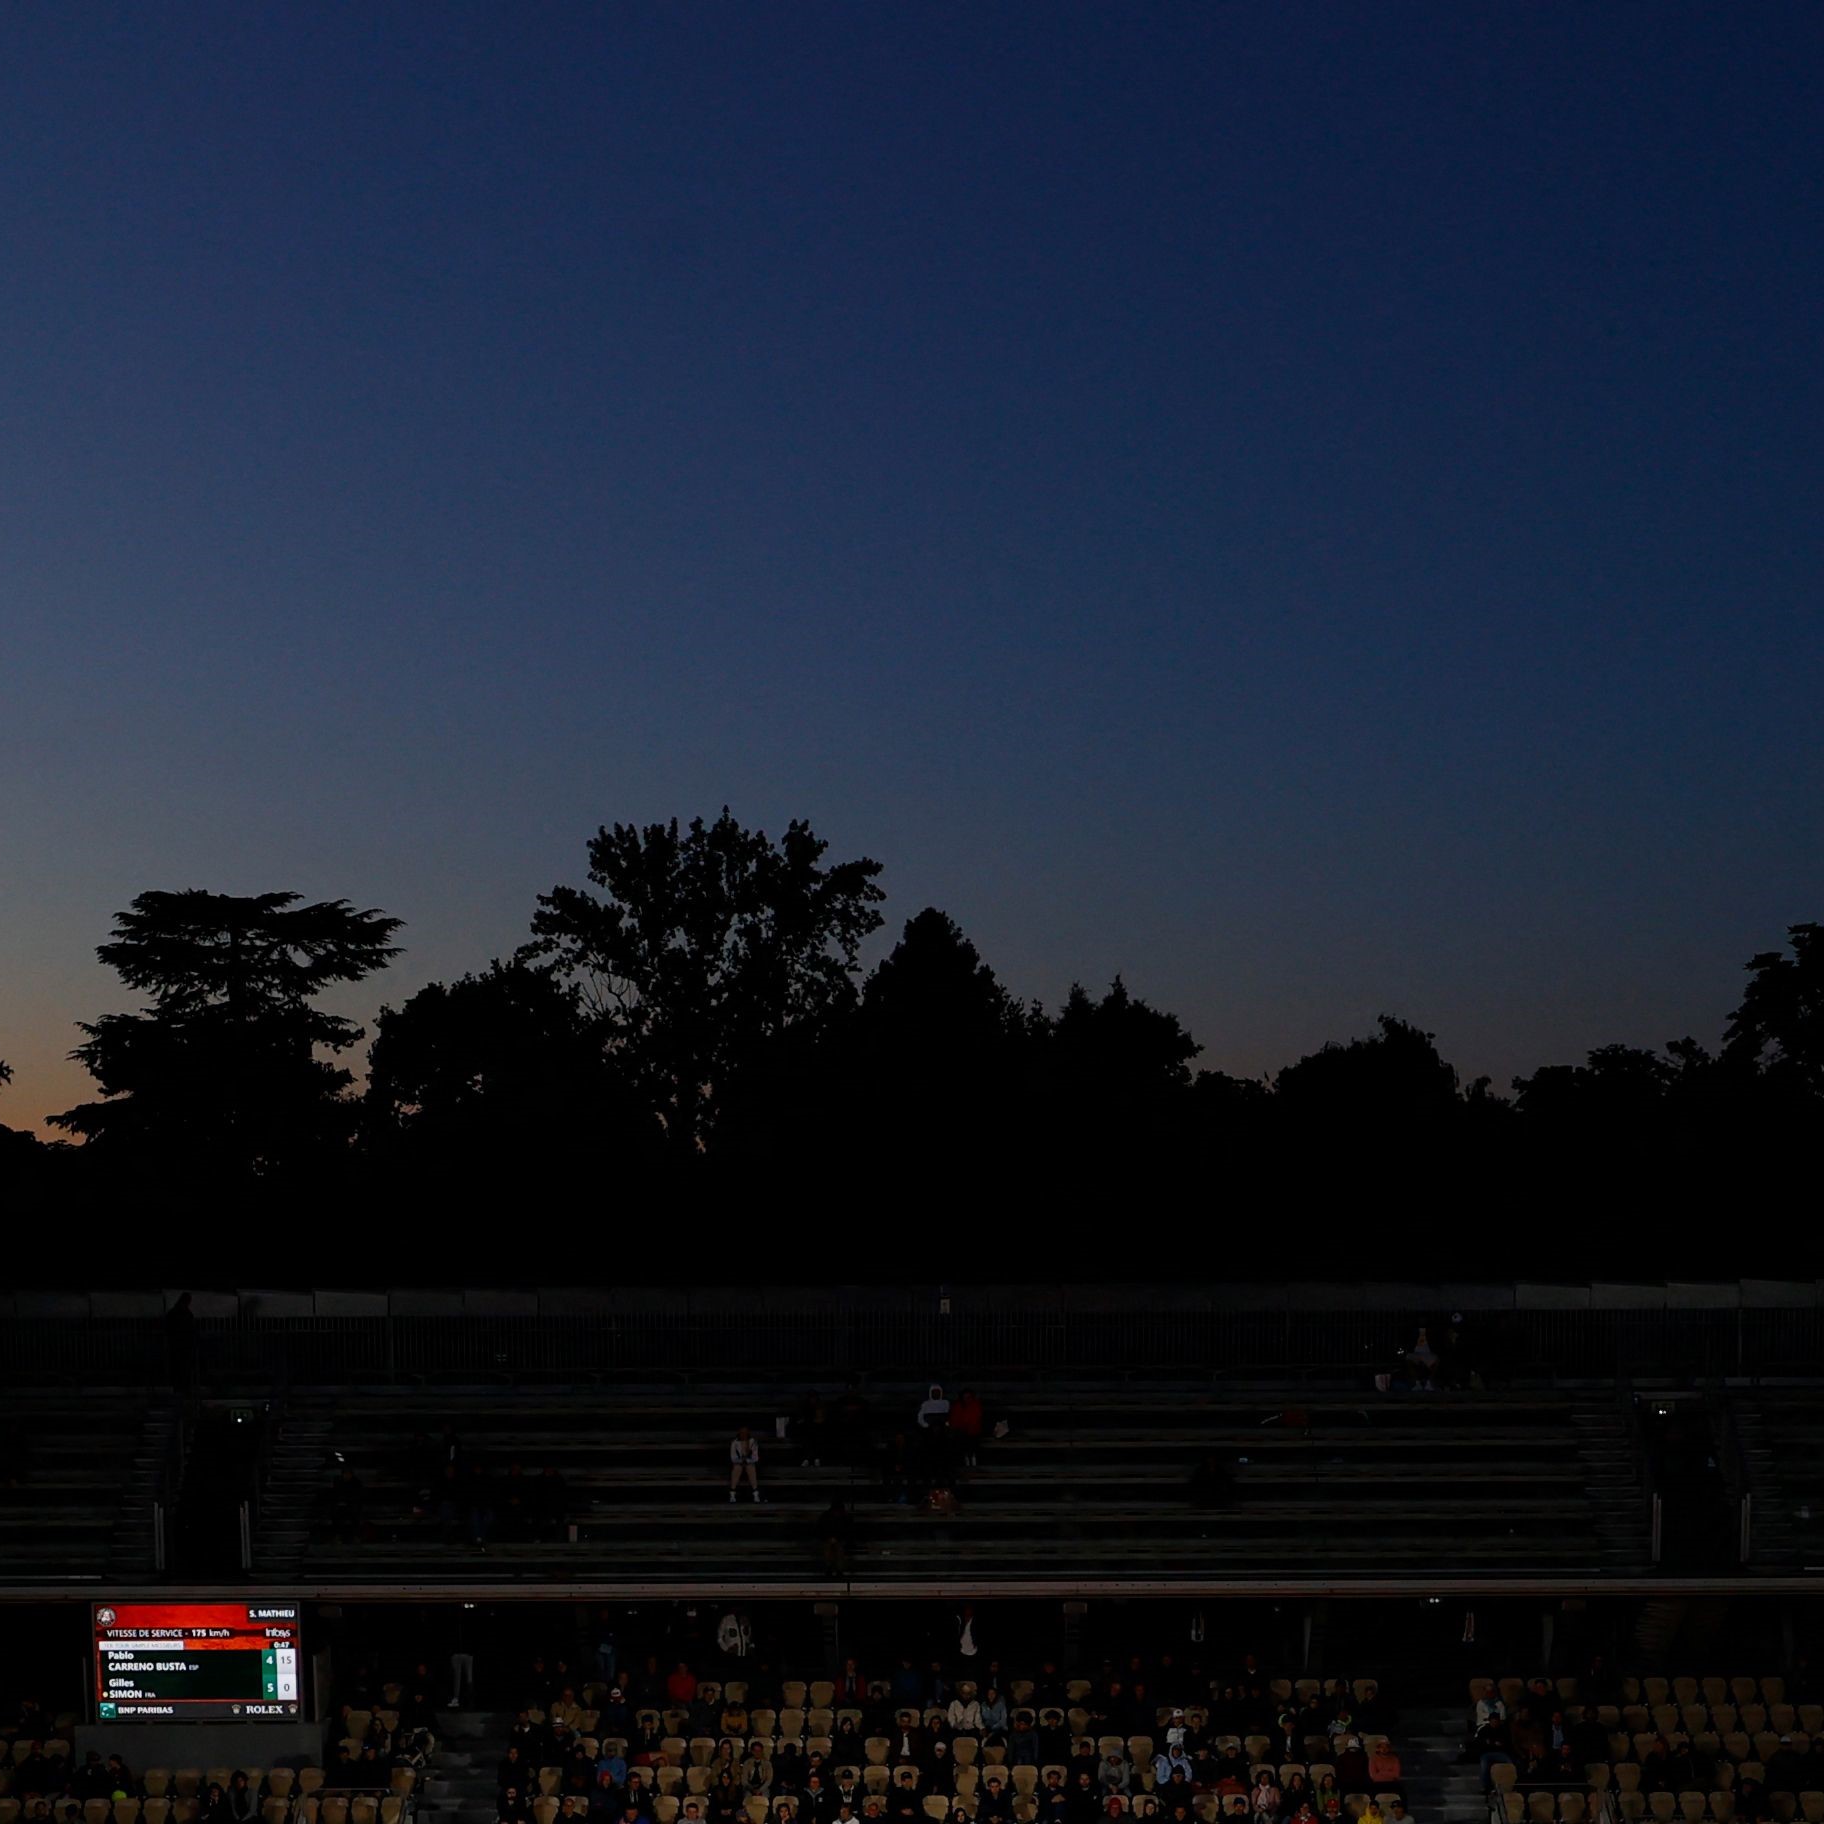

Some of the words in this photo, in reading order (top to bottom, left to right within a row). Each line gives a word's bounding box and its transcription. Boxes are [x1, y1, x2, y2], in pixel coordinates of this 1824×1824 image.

[258, 1609, 295, 1618] MATHIEU
[106, 1629, 138, 1637] VITESSE
[138, 1629, 150, 1637] DE
[151, 1629, 184, 1637] SERVICE
[191, 1629, 207, 1637] 175
[209, 1629, 230, 1637] km/h
[273, 1641, 290, 1649] 0:47
[108, 1651, 134, 1660] Pablo
[265, 1656, 273, 1665] 4
[280, 1656, 292, 1664] 15
[108, 1662, 155, 1671] CARRENO
[156, 1662, 187, 1671] BUSTA
[108, 1678, 135, 1687] Gilles
[267, 1683, 274, 1692] 5
[283, 1684, 290, 1692] 0
[109, 1690, 143, 1698] SIMON
[117, 1706, 136, 1714] BNP
[137, 1706, 174, 1714] PARIBAS
[245, 1705, 284, 1714] ROLEX
